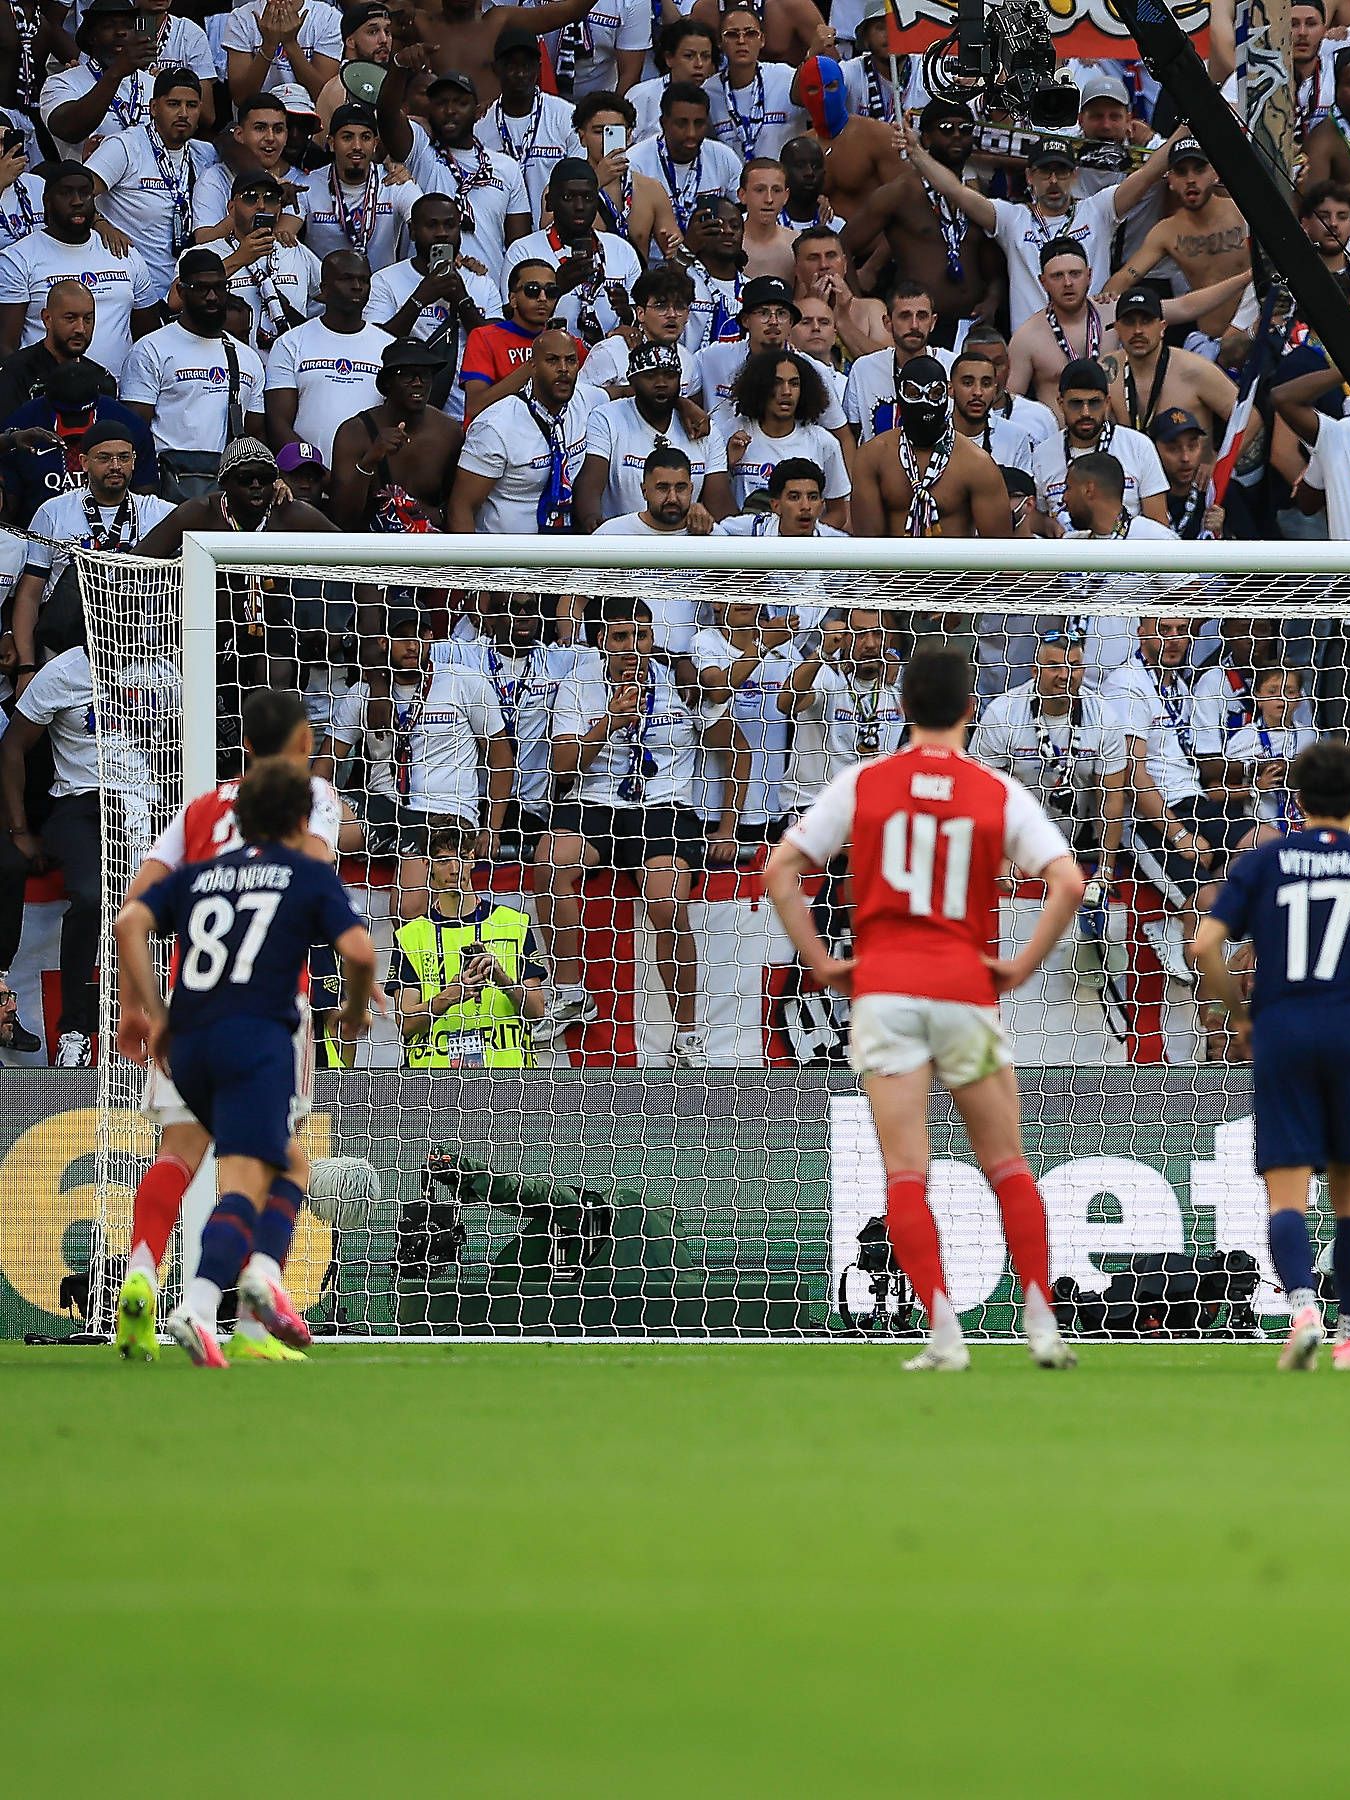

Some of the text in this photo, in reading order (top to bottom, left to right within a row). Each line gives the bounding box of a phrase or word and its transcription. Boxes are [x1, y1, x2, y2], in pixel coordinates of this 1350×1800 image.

[99, 271, 129, 283] AUTEUIL
[230, 278, 252, 288] RAGE
[302, 361, 381, 373] VIRAGE AUTE
[179, 370, 208, 381] VIRAGE
[626, 456, 646, 468] VIRA
[45, 472, 81, 490] QAT
[425, 713, 456, 723] UTEUIL
[883, 811, 975, 920] 41
[181, 889, 283, 992] 87
[408, 1022, 537, 1062] SECRITY
